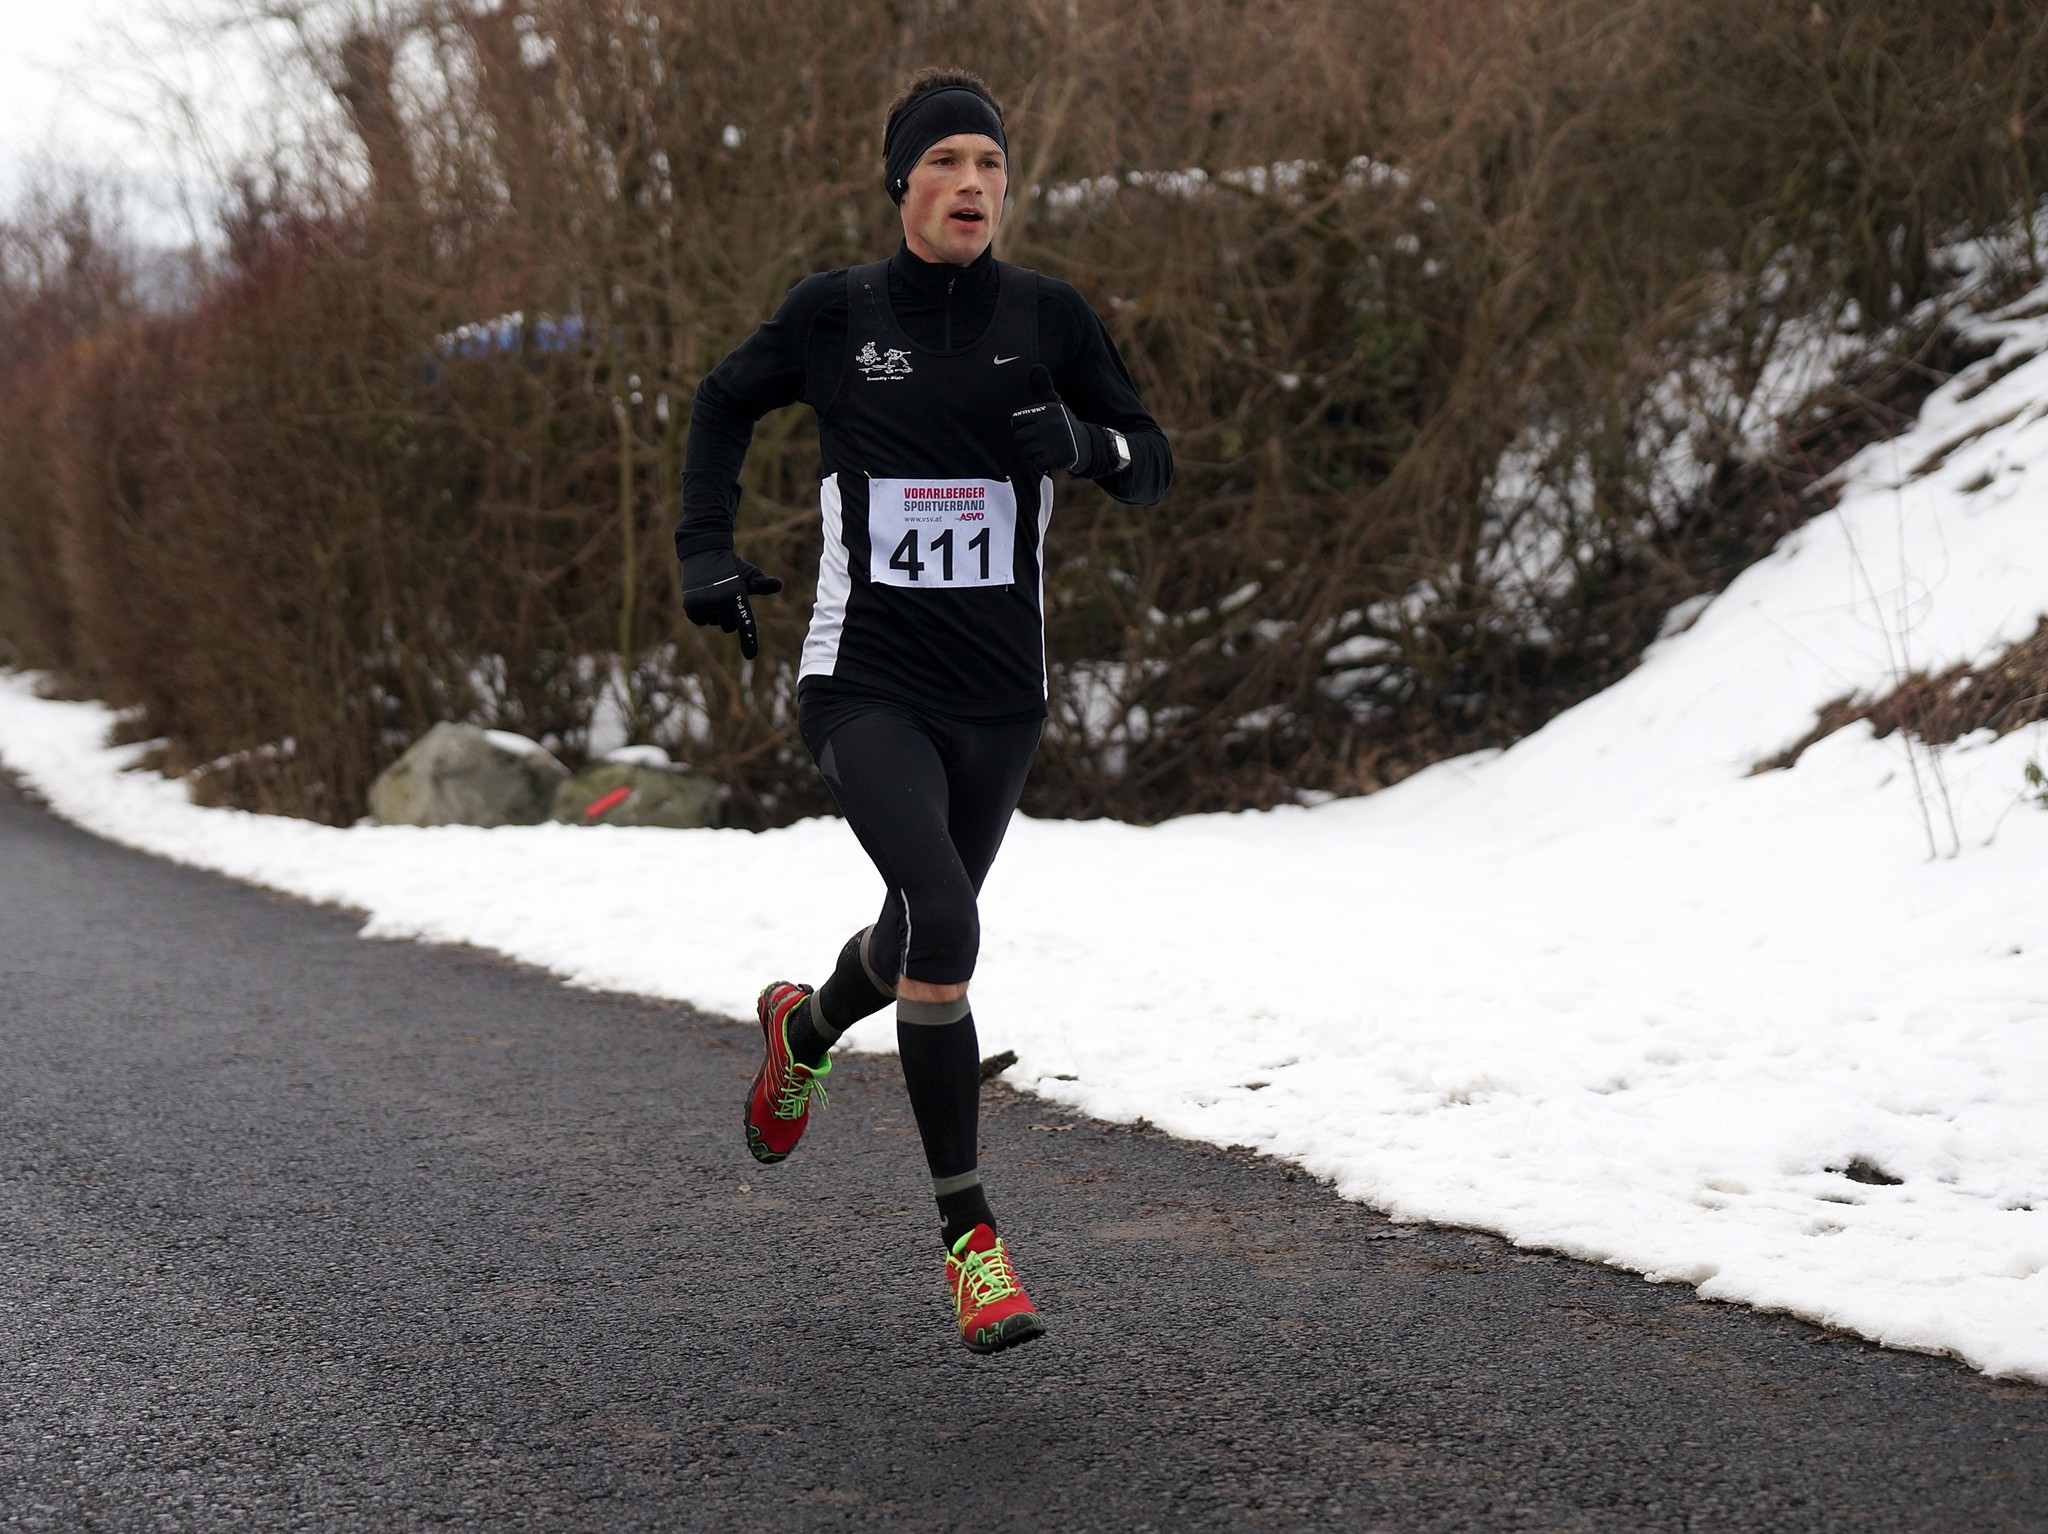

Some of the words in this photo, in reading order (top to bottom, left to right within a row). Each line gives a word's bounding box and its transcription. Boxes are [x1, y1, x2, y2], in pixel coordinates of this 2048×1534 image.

[904, 487, 985, 499] VORARLBERGER
[904, 500, 985, 512] SPORTVERBAND
[889, 527, 990, 581] 411
